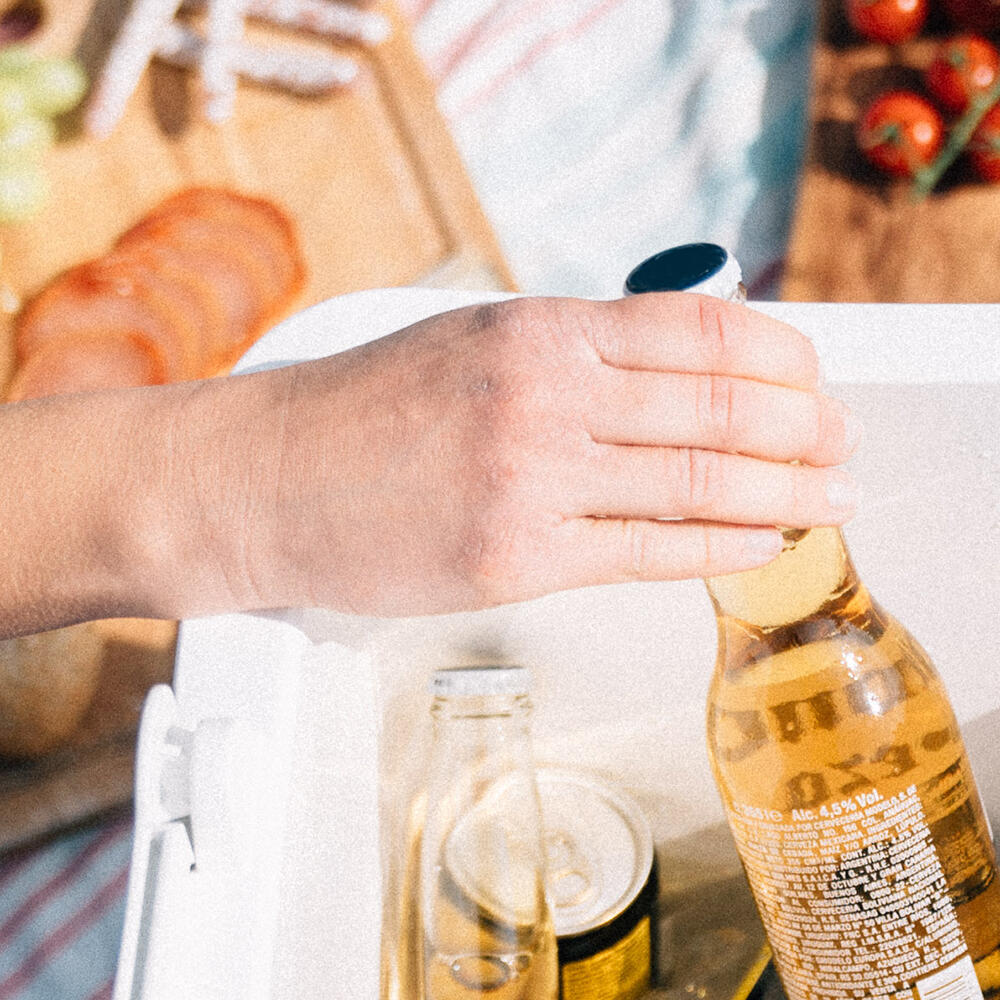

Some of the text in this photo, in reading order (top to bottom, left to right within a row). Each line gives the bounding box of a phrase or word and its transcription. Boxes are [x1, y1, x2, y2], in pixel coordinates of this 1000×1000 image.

[792, 808, 817, 821] Alc.
[820, 798, 856, 817] 4,5%
[857, 788, 882, 809] Vol.
[844, 840, 860, 850] Y/O
[840, 850, 888, 870] ARGENTINA:
[841, 848, 866, 860] CONT.
[831, 876, 869, 888] OCTUBRE
[880, 862, 903, 878] GRAN
[823, 886, 857, 898] BUENOS
[811, 904, 860, 914] CERVECERIA
